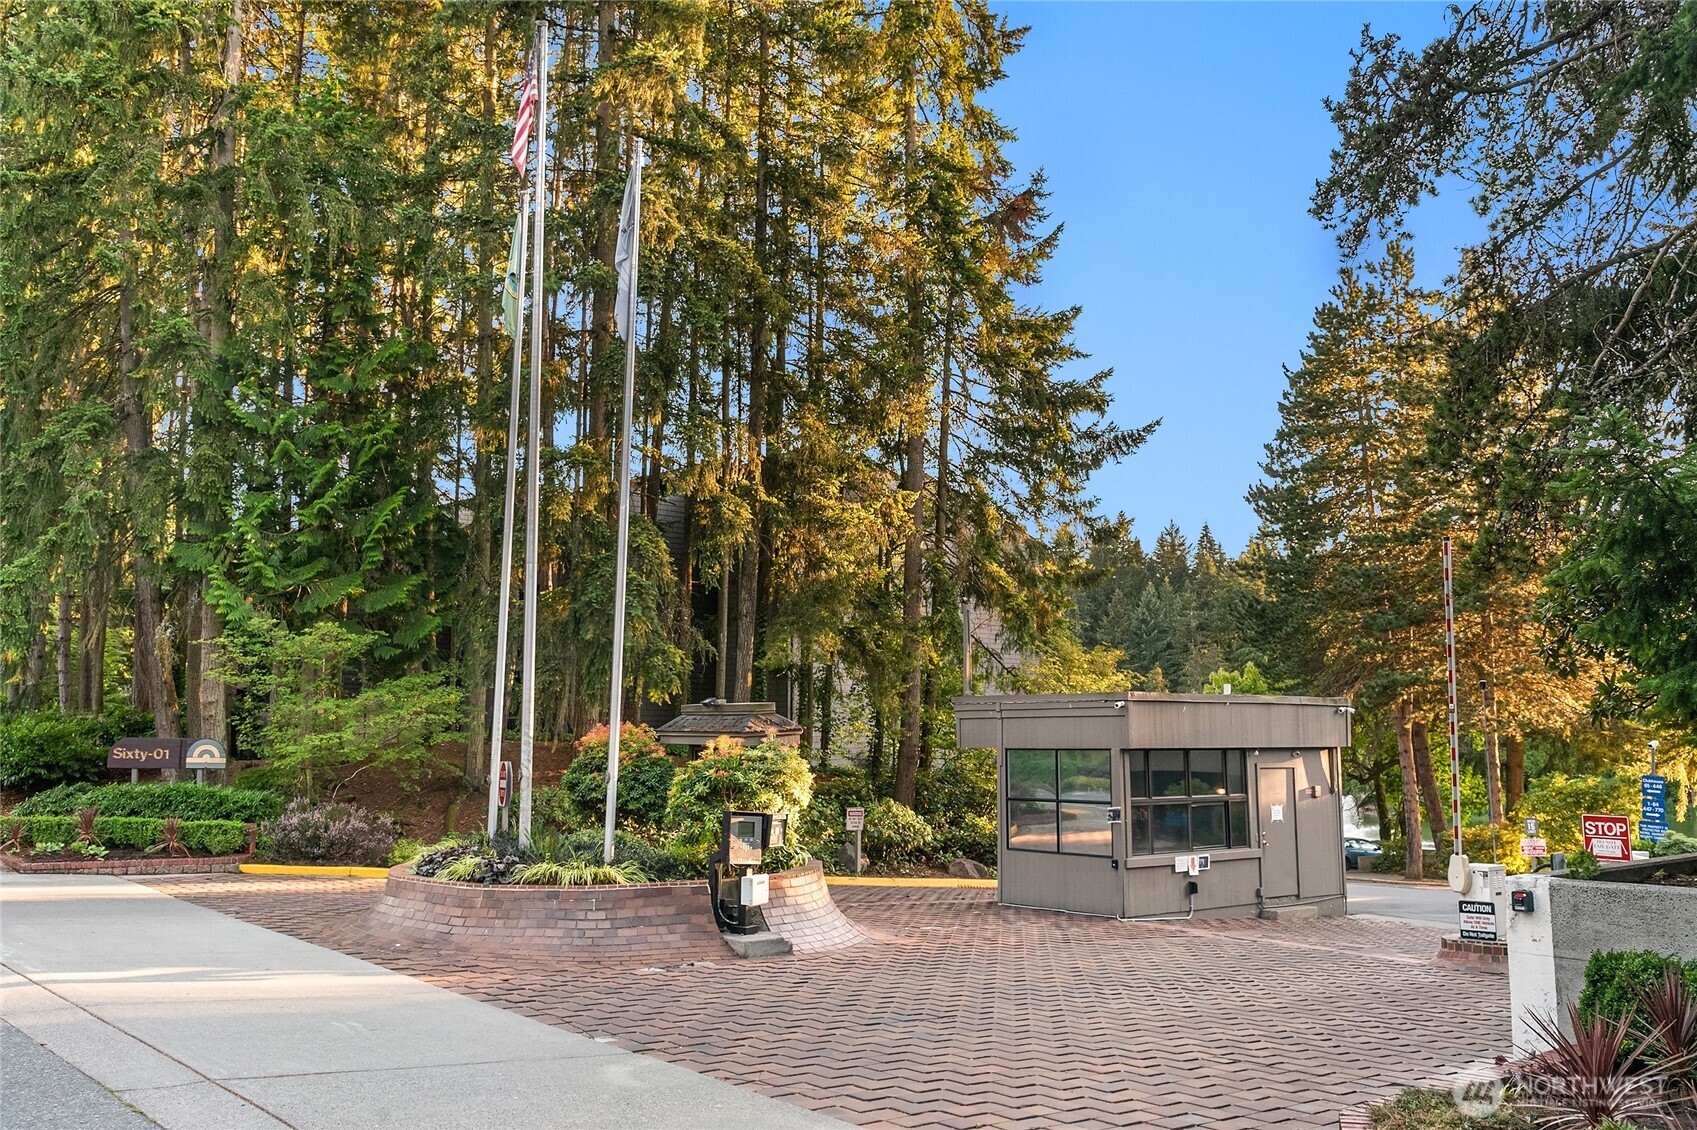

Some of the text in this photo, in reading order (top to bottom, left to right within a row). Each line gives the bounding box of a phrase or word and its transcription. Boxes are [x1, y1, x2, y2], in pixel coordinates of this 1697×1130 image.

[112, 748, 170, 762] Sixty-01
[1585, 821, 1626, 836] STOP
[1462, 904, 1492, 912] CAUTION
